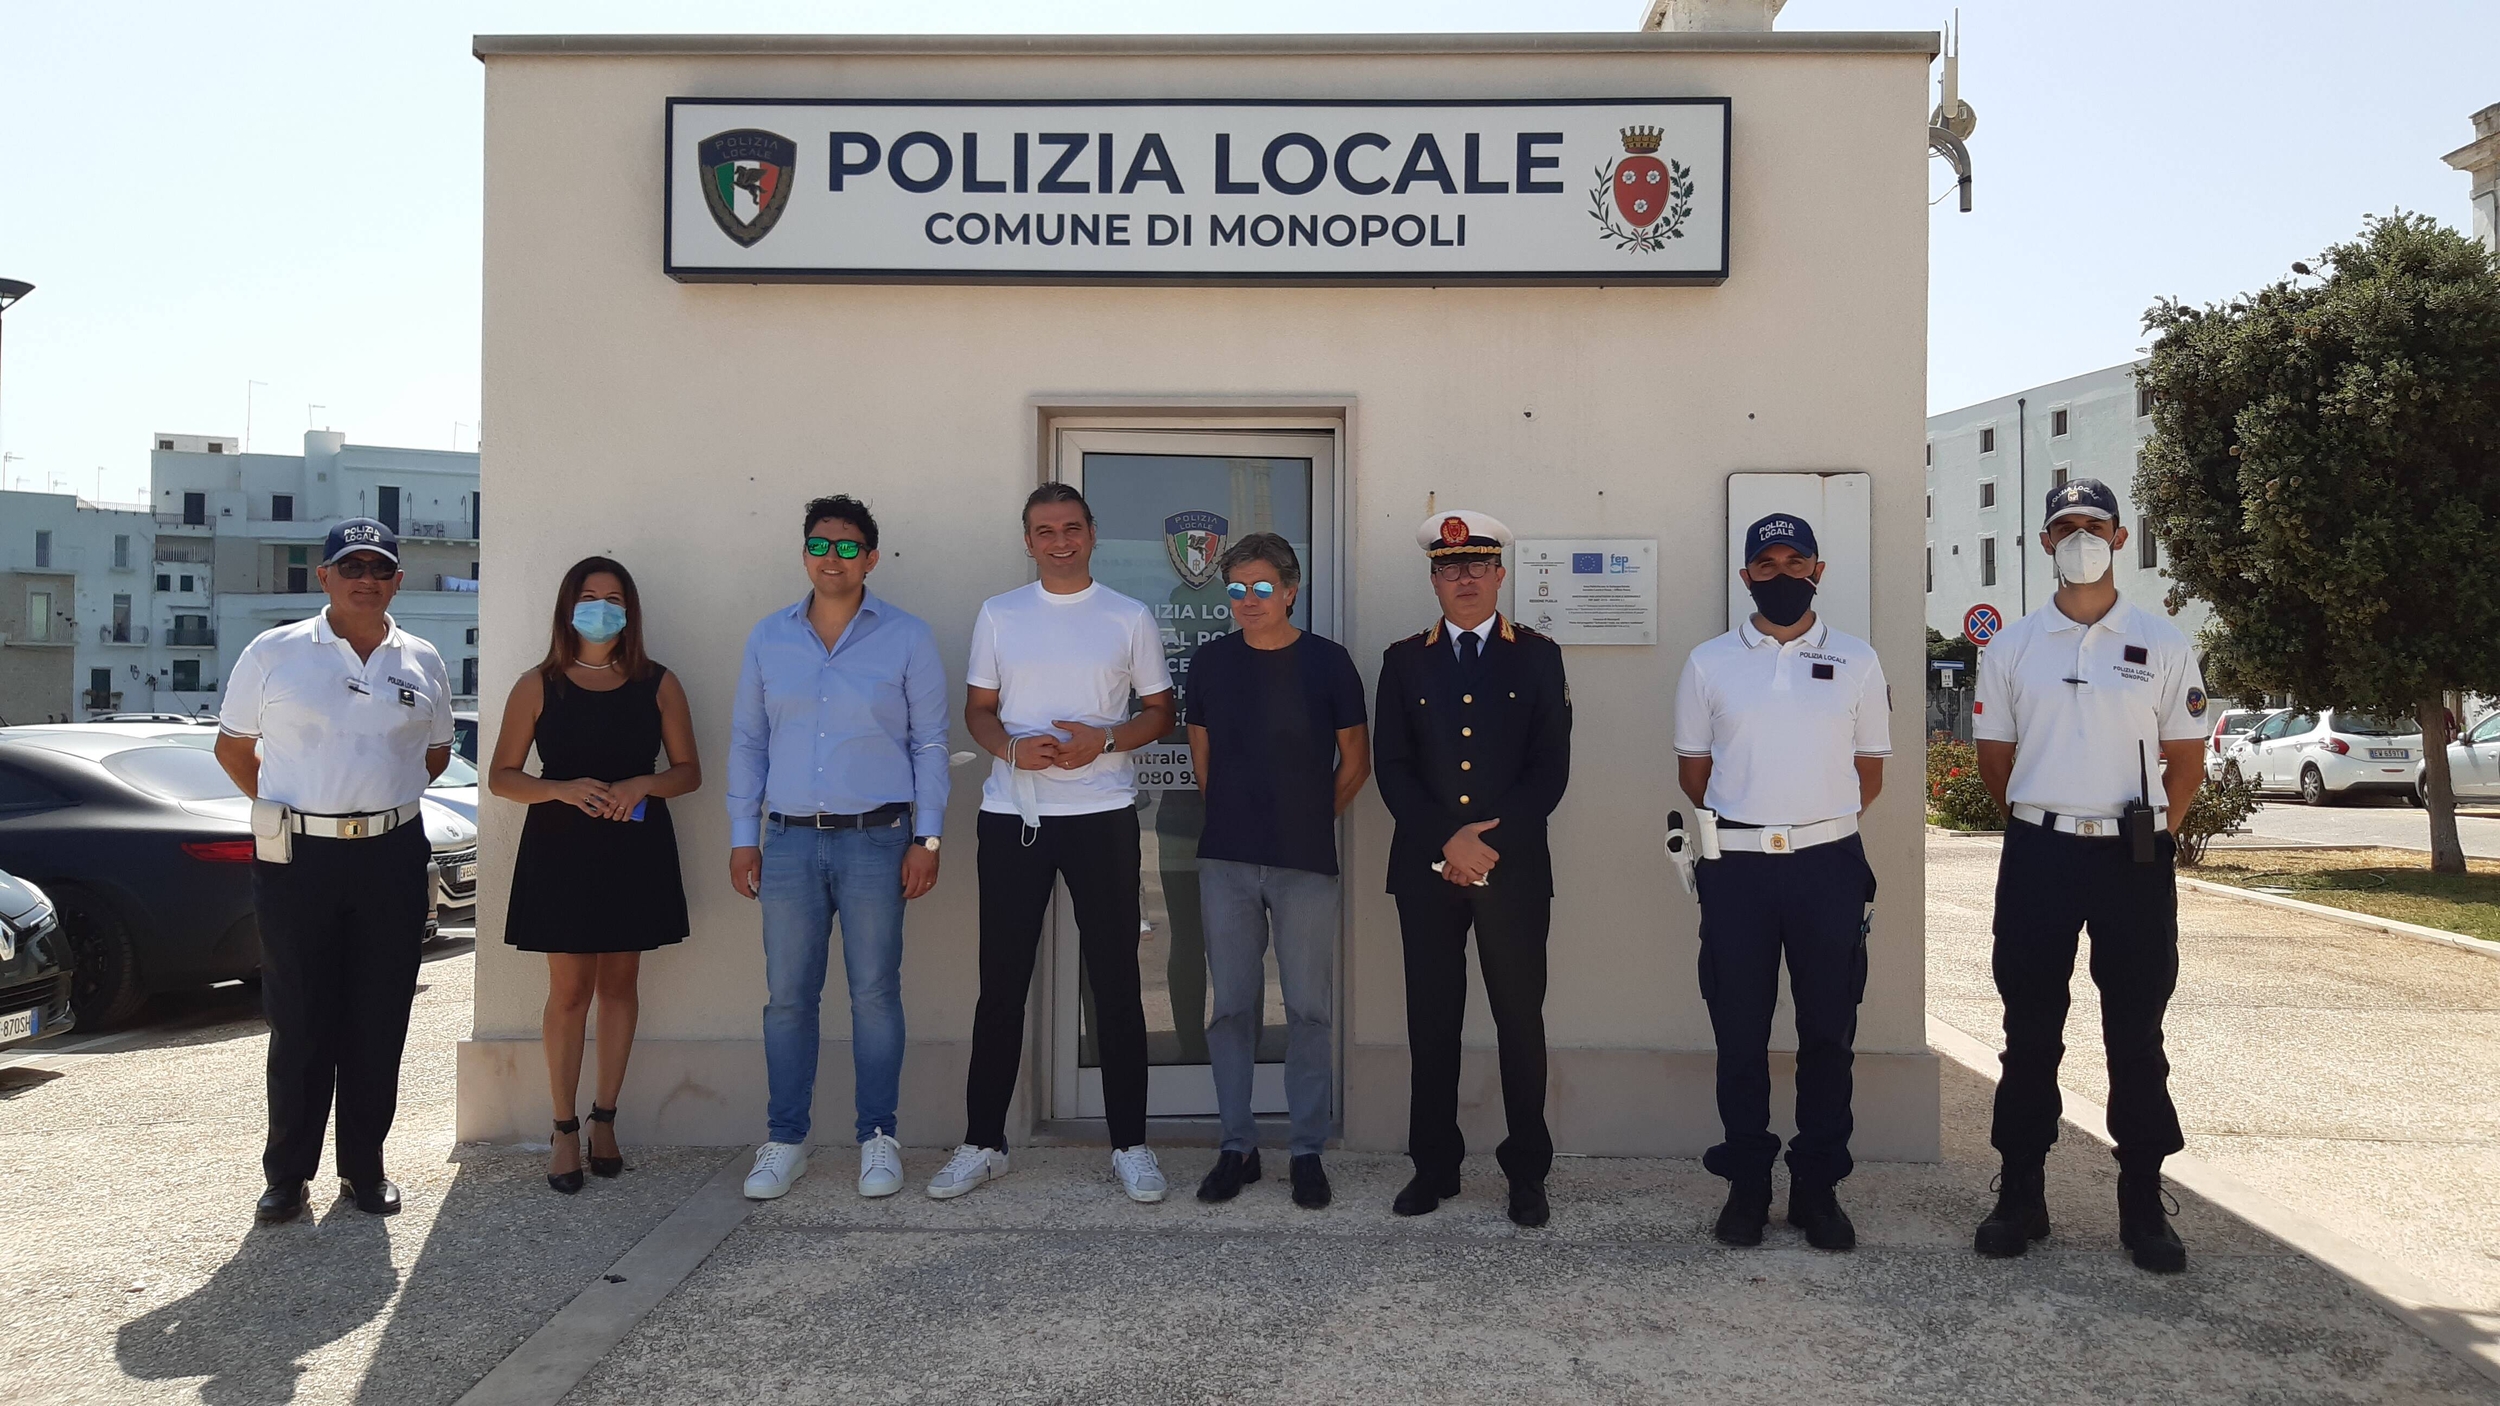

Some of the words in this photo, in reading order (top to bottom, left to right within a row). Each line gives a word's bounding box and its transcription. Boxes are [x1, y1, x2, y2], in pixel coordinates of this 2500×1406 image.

[715, 137, 778, 150] POLIZIA
[723, 149, 772, 159] LOCALE
[829, 131, 1185, 194] POLIZIA
[1215, 132, 1564, 195] LOCALE
[925, 212, 1130, 246] COMUNE
[1148, 214, 1191, 246] DI
[1209, 214, 1465, 247] MONOPOLI
[2073, 485, 2099, 500] LOCALE
[1174, 515, 1217, 524] POLIZIA
[1180, 522, 1213, 530] LOCALE
[343, 525, 381, 536] POLIZIA
[1759, 520, 1795, 534] POLIZIA
[345, 533, 380, 542] LOCALE
[1760, 528, 1794, 541] LOCALE
[1610, 553, 1629, 573] fep
[1154, 604, 1196, 619] IZIA
[1202, 604, 1234, 620] LO
[1535, 623, 1552, 631] GAC
[1823, 655, 1847, 664] LOCALE
[2113, 665, 2135, 673] POLIZIA
[2135, 669, 2155, 679] LOCALE
[2121, 672, 2149, 682] MONOPOLI
[387, 676, 404, 687] POLIZIA
[404, 681, 420, 691] LOCALE
[1133, 750, 1188, 764] ntrale
[1138, 771, 1174, 785] 080
